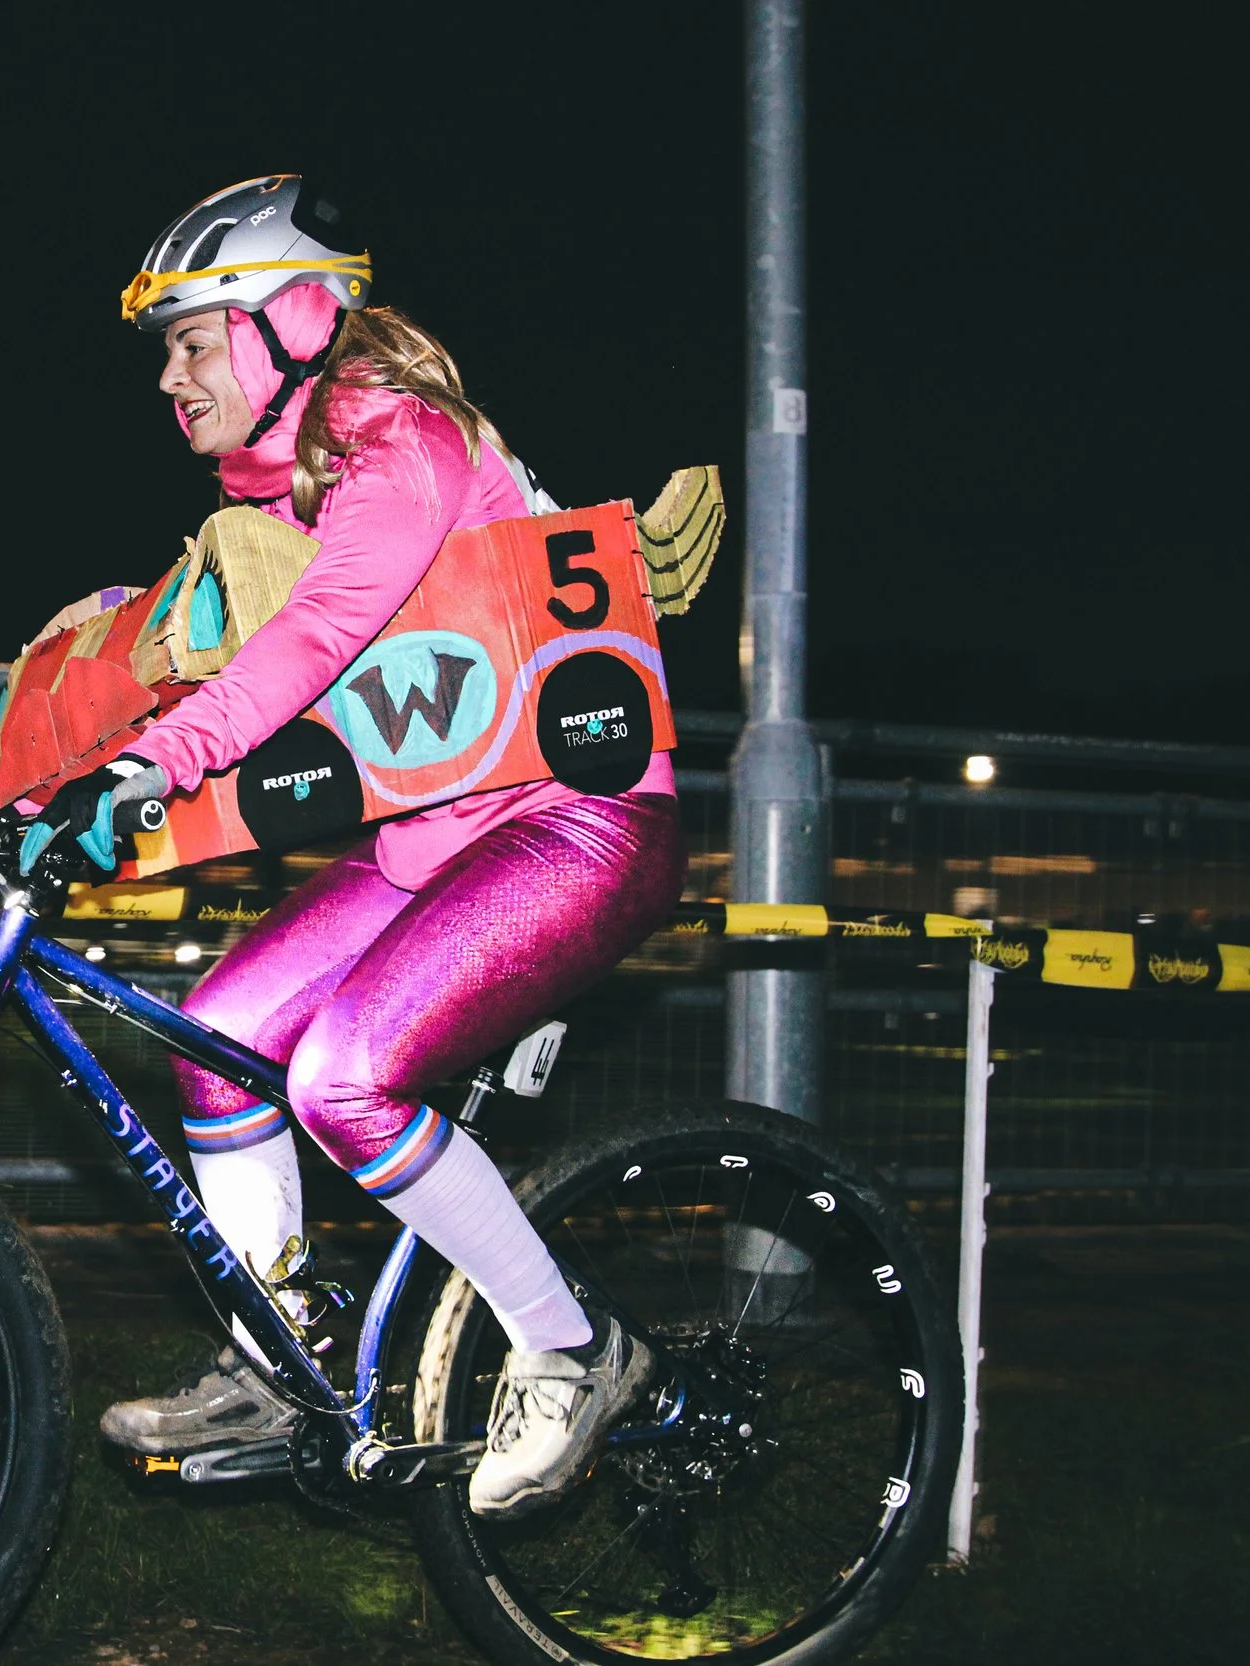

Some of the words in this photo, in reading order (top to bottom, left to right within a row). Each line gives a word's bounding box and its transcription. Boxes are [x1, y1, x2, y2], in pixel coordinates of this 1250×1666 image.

[544, 530, 610, 630] 5
[345, 647, 478, 756] W
[560, 706, 625, 728] ROTOR
[610, 722, 628, 739] 30
[262, 766, 332, 791] ROTOR
[105, 1103, 239, 1281] STAYER
[494, 1579, 550, 1650] TERAVAIL
